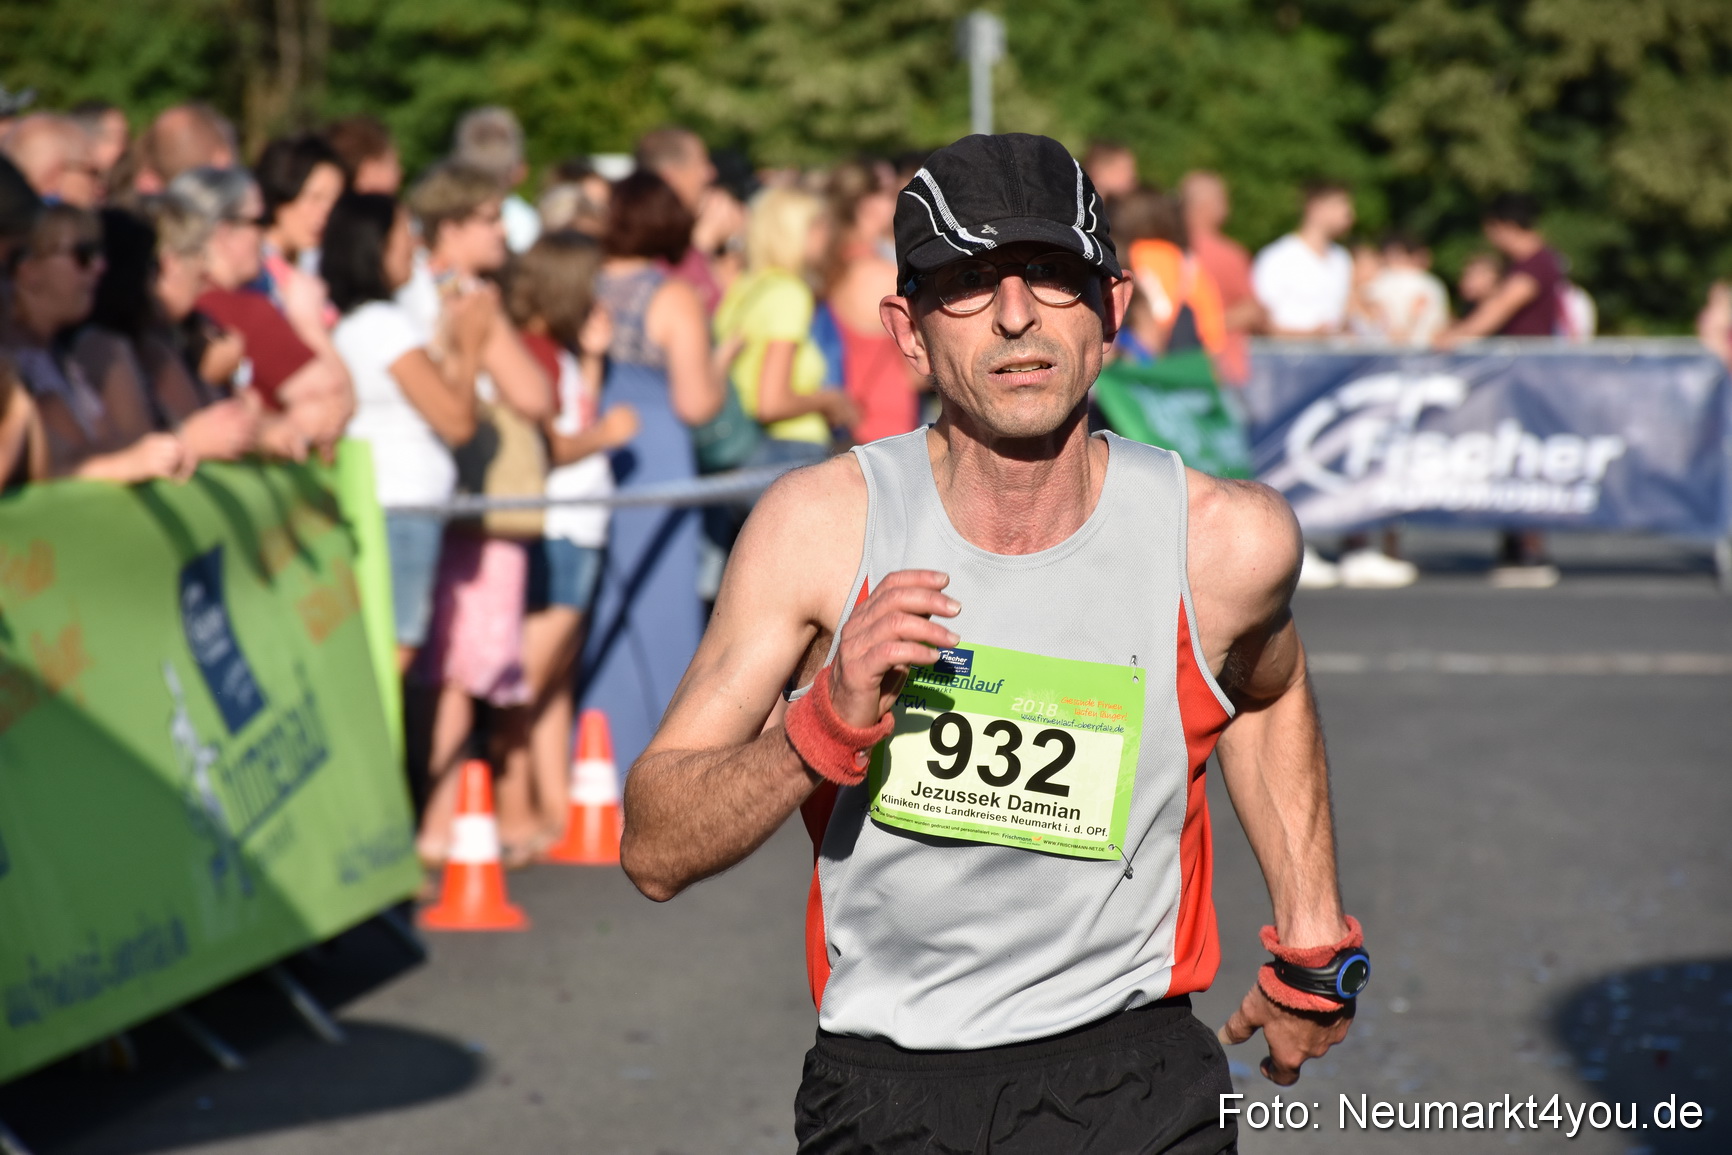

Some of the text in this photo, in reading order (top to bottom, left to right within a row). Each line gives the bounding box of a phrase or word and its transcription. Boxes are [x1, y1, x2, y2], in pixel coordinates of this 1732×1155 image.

[1345, 415, 1626, 484] Fischer
[941, 654, 968, 663] Fischer
[913, 684, 952, 694] neumarkt
[916, 667, 1005, 694] firmenlauf
[1011, 697, 1059, 717] 2018
[1097, 701, 1123, 710] Firmen
[926, 711, 1076, 798] 932
[911, 781, 1081, 821] Jezussek Damian
[881, 793, 1108, 837] Kliniken des Landkreises Neumarkt i. d. OPf.
[1001, 833, 1033, 842] Frischmann
[1043, 839, 1105, 852] WWW.FRISCHMANN-NET.DE
